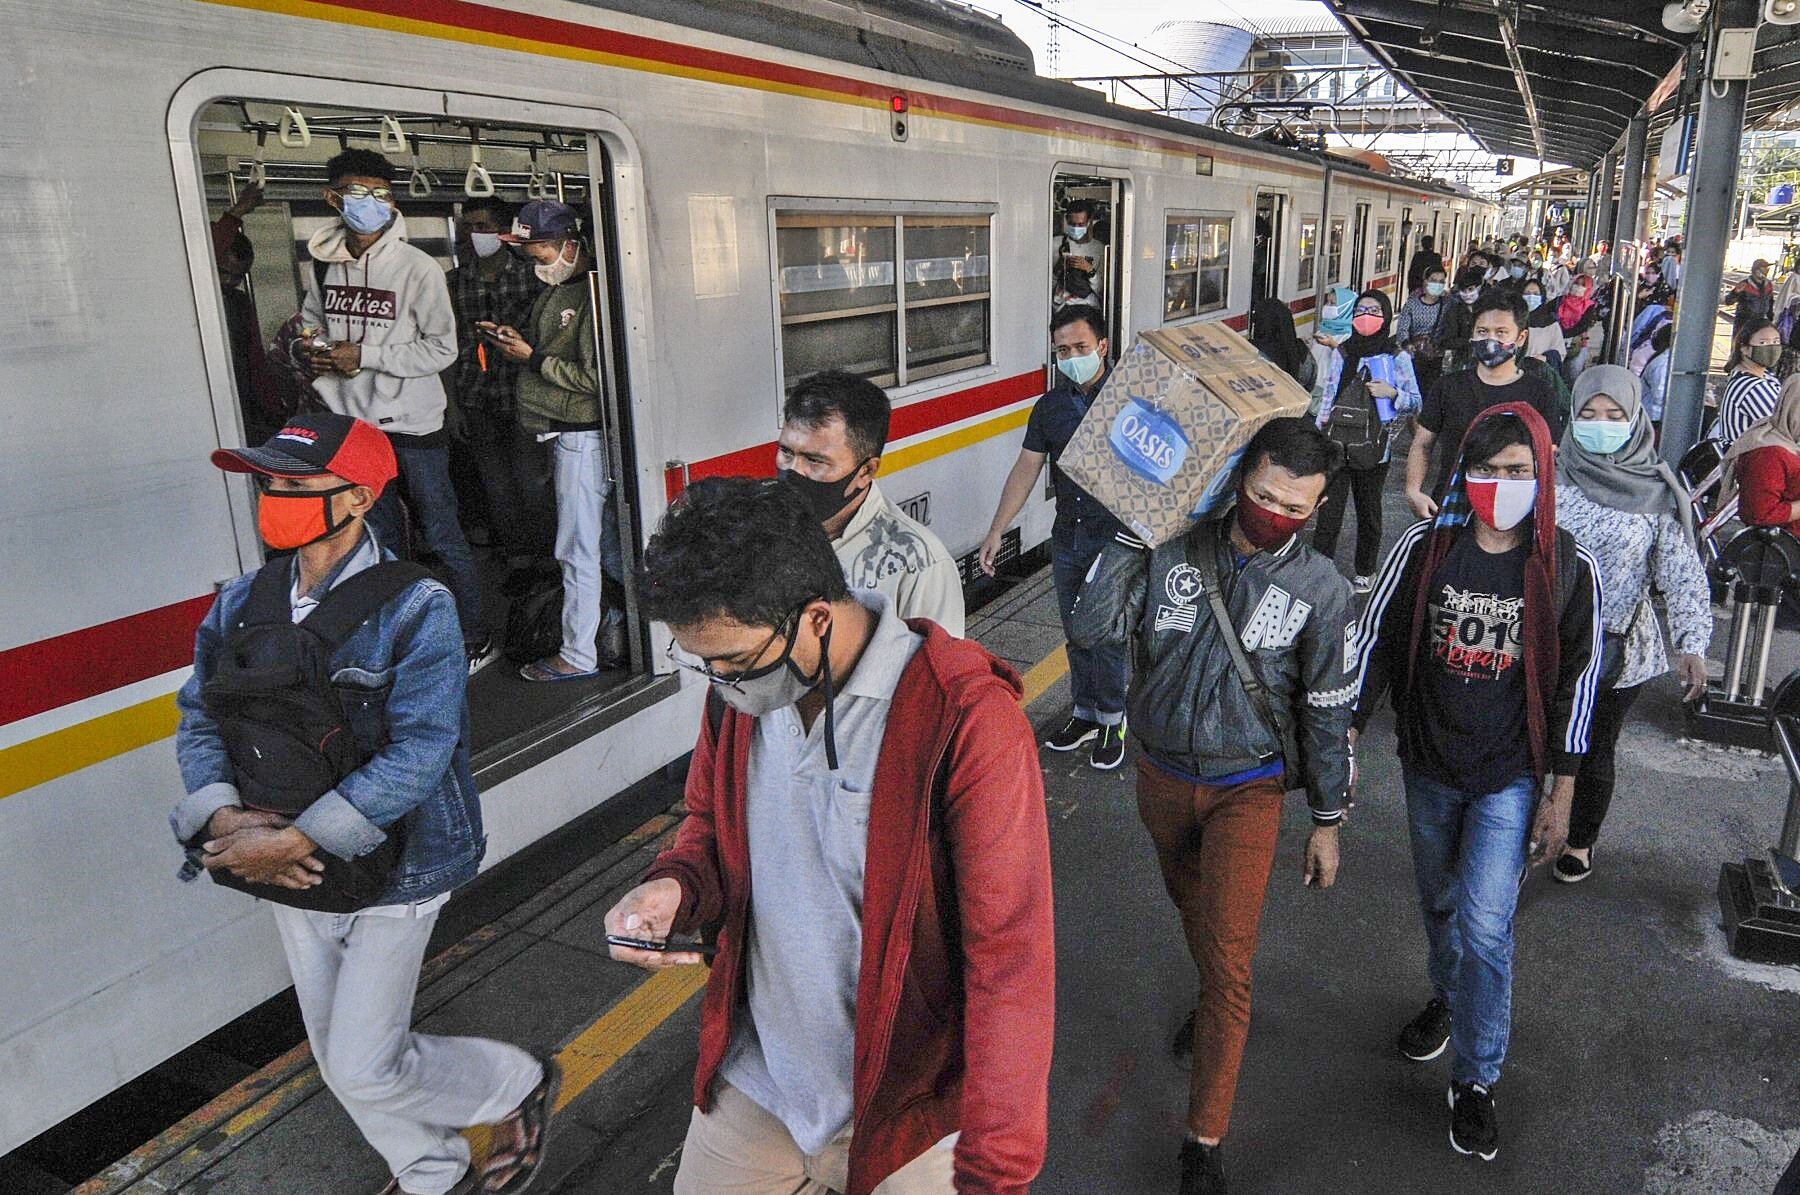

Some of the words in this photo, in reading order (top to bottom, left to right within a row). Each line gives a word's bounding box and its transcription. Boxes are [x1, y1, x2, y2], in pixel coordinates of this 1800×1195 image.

[1501, 160, 1510, 173] 3
[324, 289, 393, 315] Dickies
[1121, 415, 1176, 470] OASIS
[902, 496, 928, 523] 07
